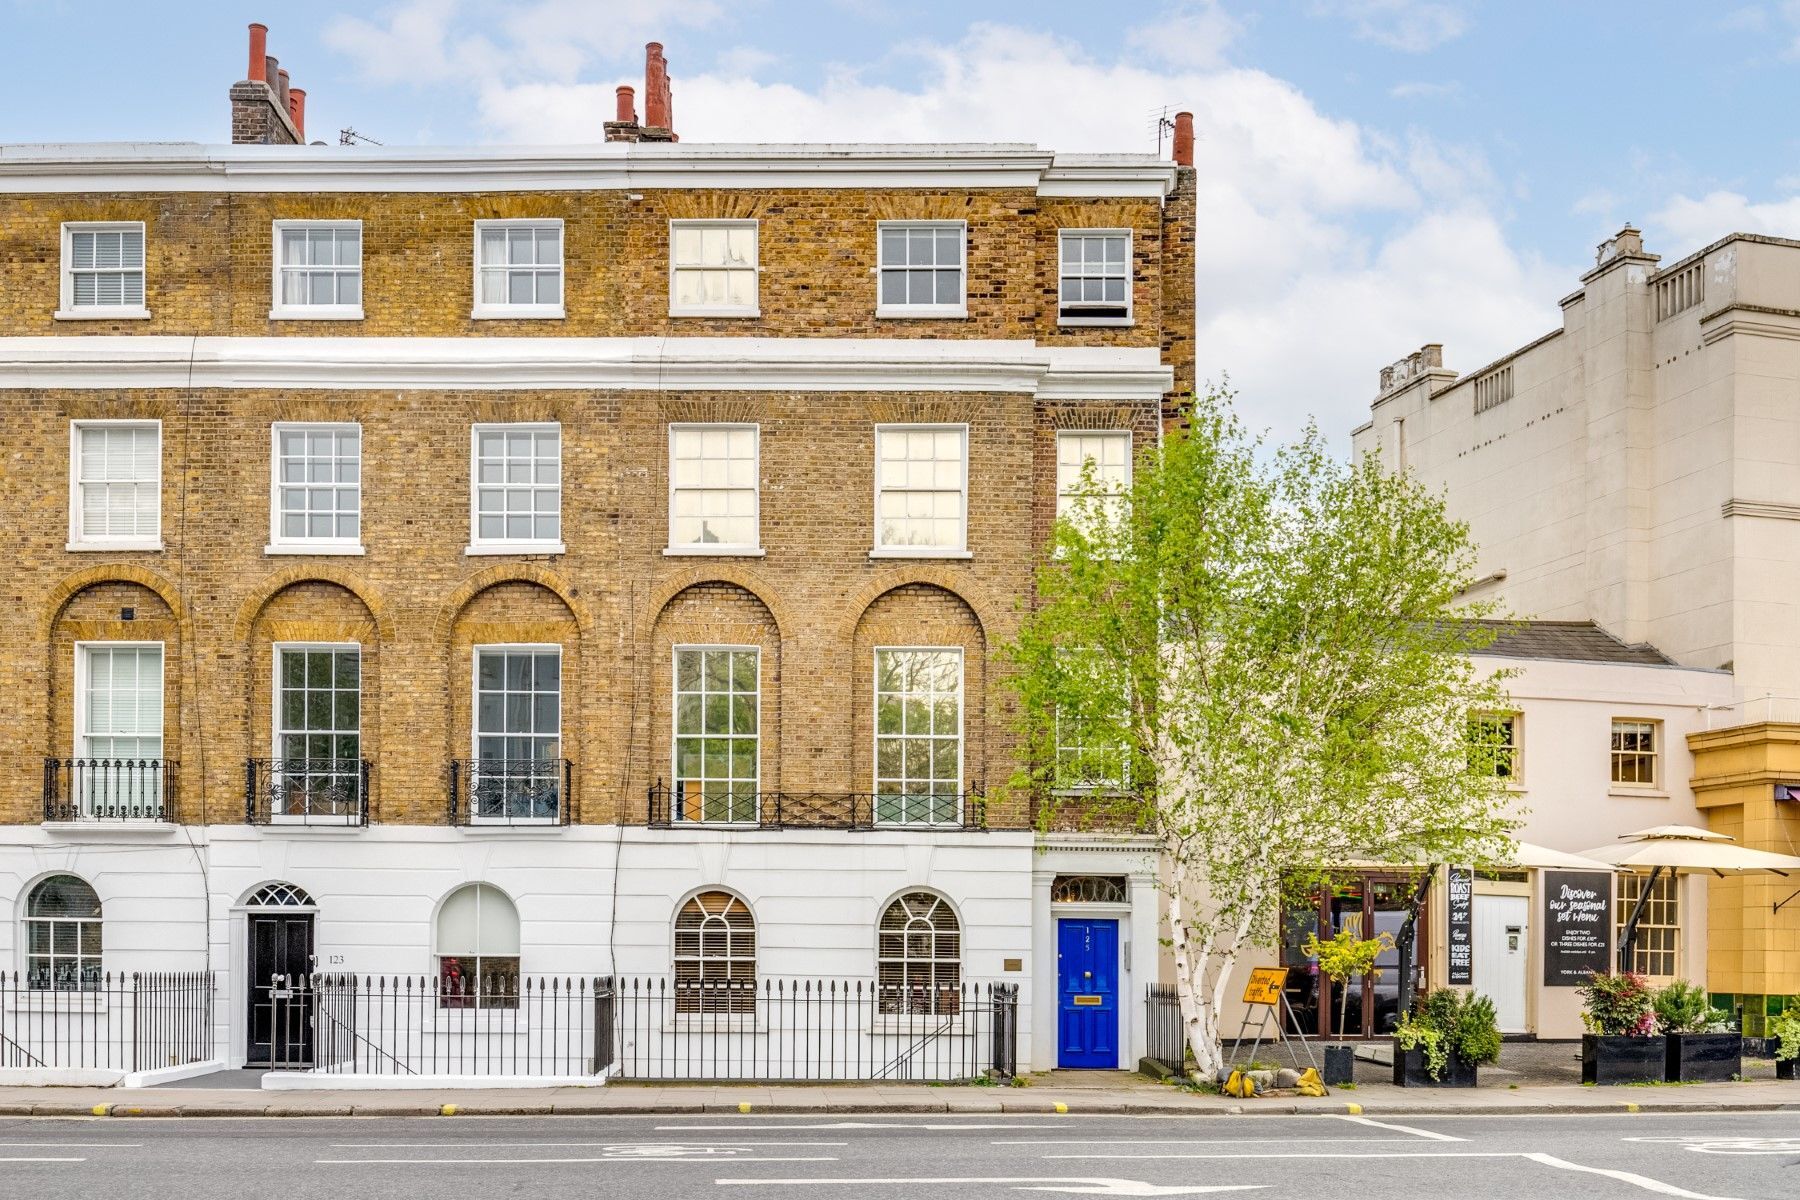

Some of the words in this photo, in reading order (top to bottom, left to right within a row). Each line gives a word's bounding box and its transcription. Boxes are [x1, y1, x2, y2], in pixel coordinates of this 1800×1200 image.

[1450, 882, 1471, 893] ROAST
[1560, 884, 1597, 900] Discover
[1549, 899, 1567, 910] our
[1569, 899, 1606, 911] seasonal
[1557, 910, 1572, 922] set
[1451, 944, 1471, 953] KIDS
[329, 955, 344, 964] 123
[1451, 958, 1470, 967] FREE
